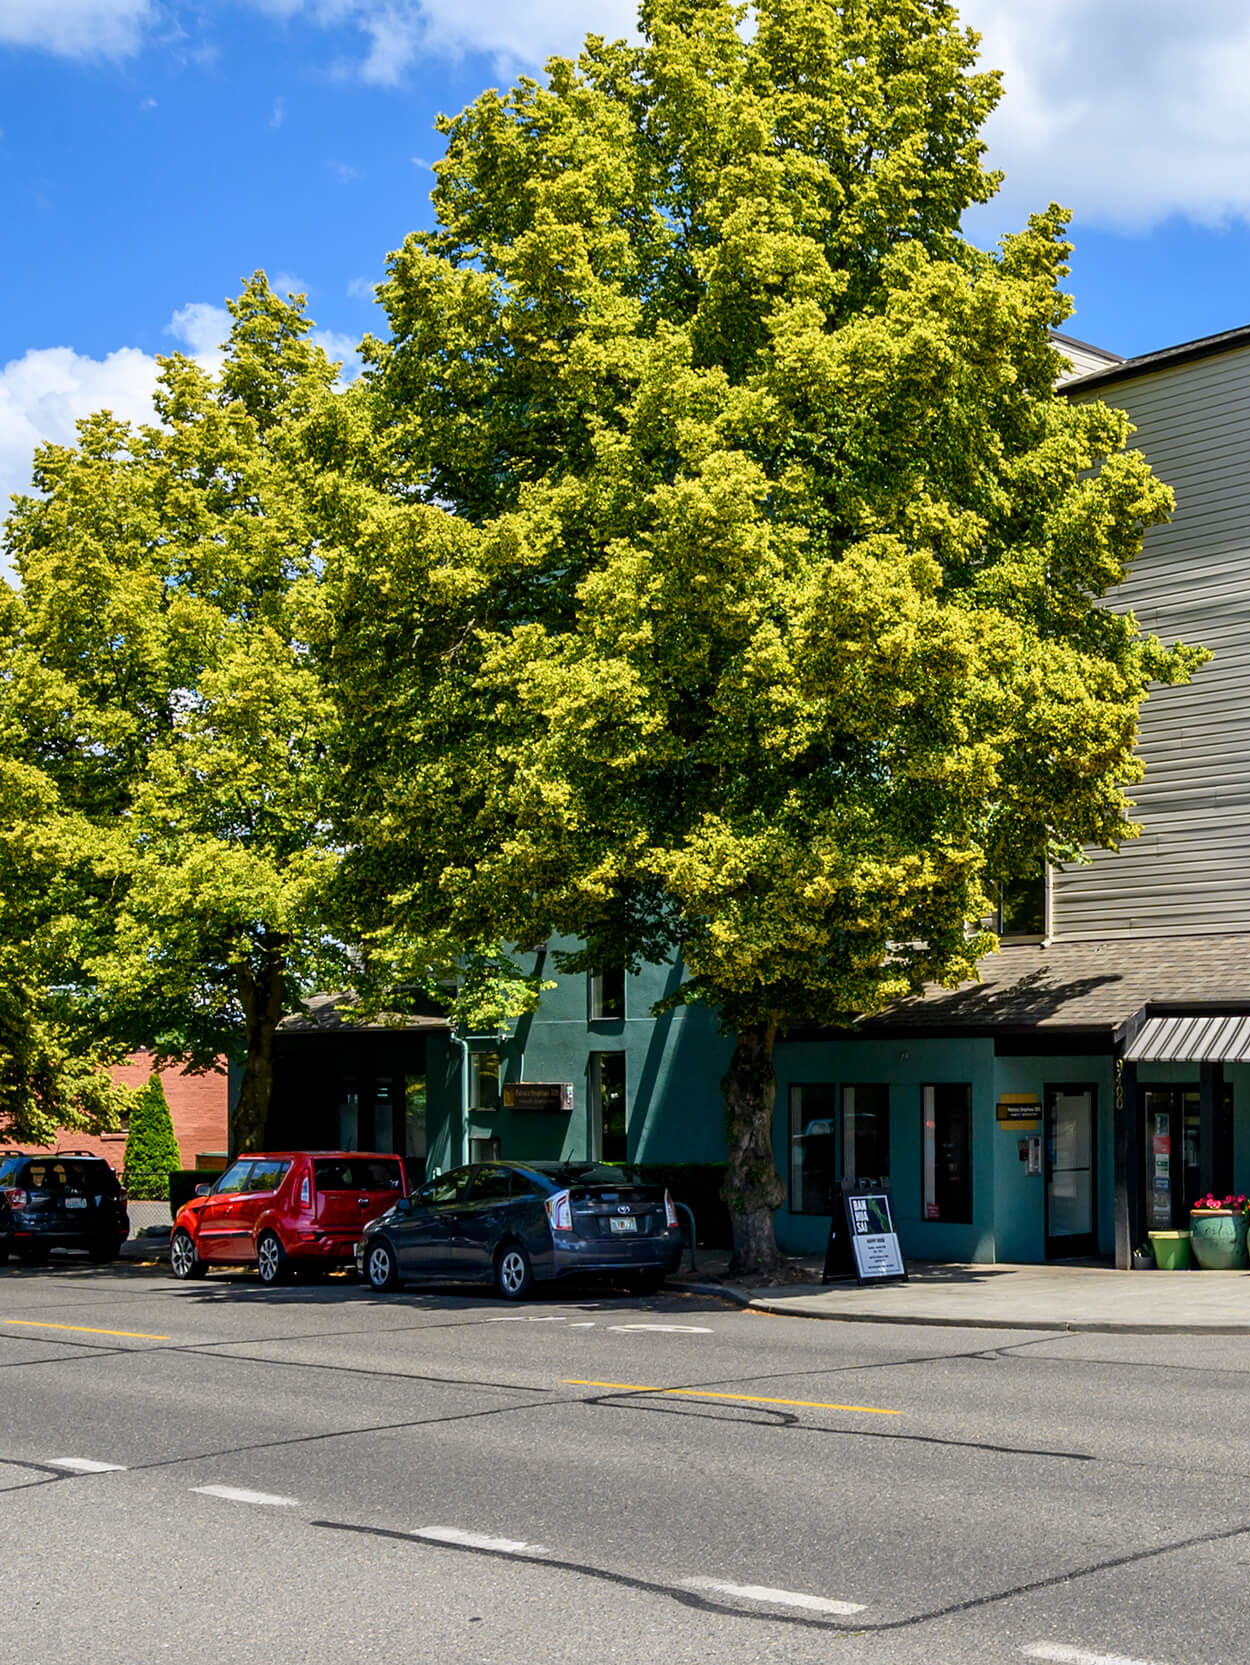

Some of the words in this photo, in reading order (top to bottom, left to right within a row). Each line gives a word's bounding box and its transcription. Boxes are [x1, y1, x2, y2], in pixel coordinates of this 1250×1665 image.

[1115, 1058, 1124, 1110] 9400
[853, 1200, 867, 1211] BAN
[856, 1222, 868, 1233] SAI
